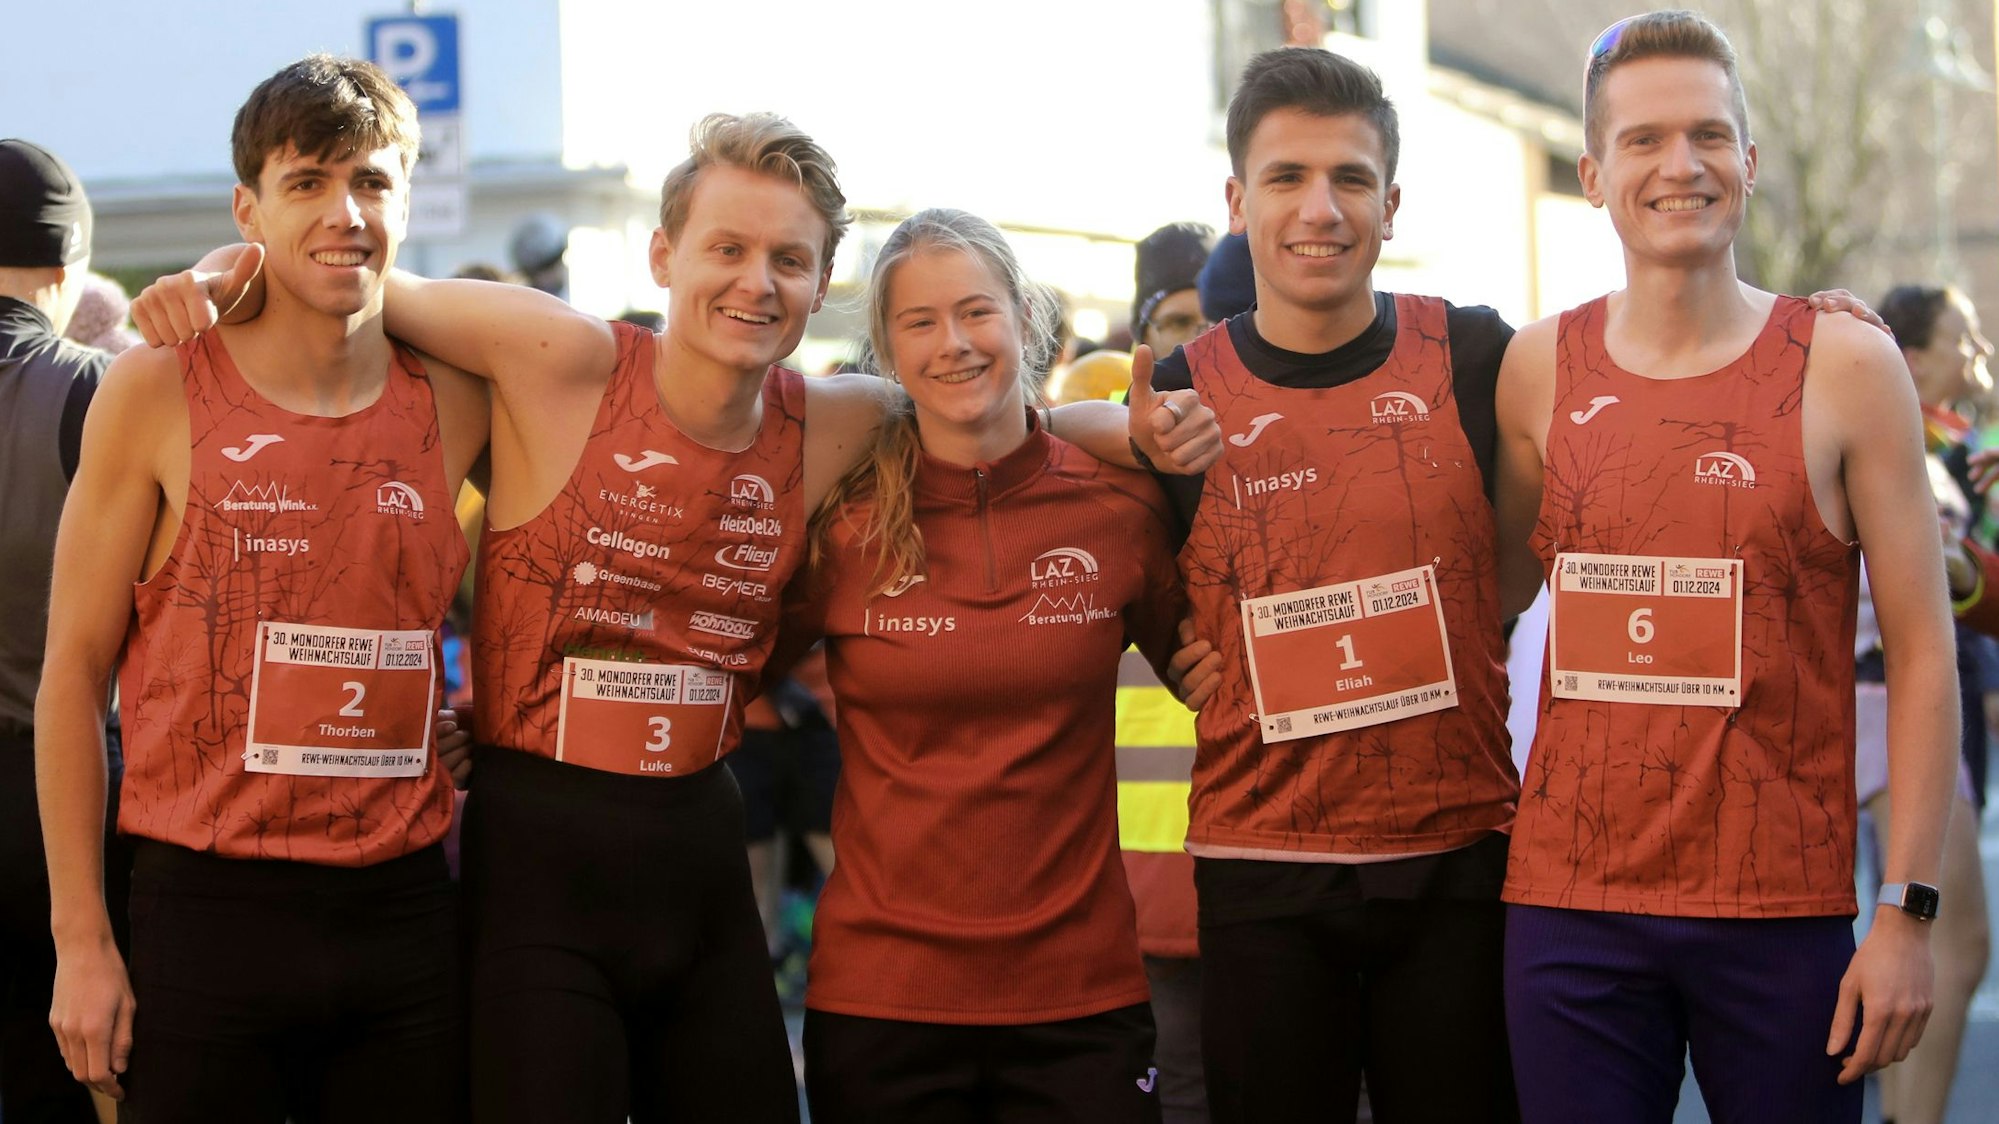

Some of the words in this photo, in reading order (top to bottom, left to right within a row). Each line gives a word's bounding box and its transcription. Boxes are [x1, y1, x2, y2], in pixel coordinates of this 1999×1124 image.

[1370, 400, 1409, 417] LAZ
[1372, 414, 1430, 424] RHEIN-SIEG
[1696, 459, 1736, 478] LAZ
[1246, 467, 1318, 496] inasys
[1694, 476, 1756, 490] RHEIN-SIEG
[377, 489, 408, 508] LAZ
[731, 482, 758, 500] LAZ
[223, 500, 276, 512] Beratung
[600, 489, 684, 519] ENERGETIX
[720, 514, 782, 537] HeizOel24
[246, 534, 310, 556] inasys
[586, 526, 670, 560] Cellagon
[734, 544, 778, 568] Fliegl
[1030, 558, 1075, 581] LAZ
[1566, 562, 1578, 574] 30.
[1580, 562, 1630, 576] MONDORFER
[1632, 565, 1656, 578] REWE
[1696, 569, 1724, 578] REWE
[599, 570, 662, 592] Greenbase
[1032, 572, 1098, 590] RHEIN-SIEG
[1392, 579, 1419, 592] REWE
[1580, 577, 1656, 592] WEIHNACHTSLAUF
[1673, 580, 1720, 594] 01.12.2024
[1258, 606, 1272, 619] 30.
[1273, 596, 1326, 616] MONDORFER
[1328, 591, 1353, 607] REWE
[1372, 592, 1418, 612] 01.12.2024
[878, 614, 956, 636] inasys
[1028, 614, 1082, 625] Beratung
[1274, 604, 1356, 630] WEIHNACHTSLAUF
[1628, 608, 1654, 644] 6
[273, 632, 288, 646] 30.
[291, 634, 346, 650] MONDORFER
[350, 638, 373, 652] REWE
[406, 641, 424, 650] REWE
[289, 648, 372, 666] WEIHNACHTSLAUF
[386, 653, 422, 666] 01.12.2024
[1335, 634, 1363, 670] 1
[1628, 652, 1653, 664] Leo
[580, 668, 594, 682] 30.
[599, 670, 652, 684] MONDORFER
[654, 674, 676, 687] REWE
[1336, 675, 1372, 692] Eliah
[596, 684, 676, 700] WEIHNACHTSLAUF
[1598, 680, 1679, 694] REWE-WEIHNACHTSLAUF
[1682, 682, 1700, 694] ÜBER
[1702, 684, 1710, 694] 10
[1713, 684, 1724, 695] KM
[339, 681, 366, 717] 2
[1314, 699, 1398, 724] REWE-WEIHNACHTSLAUF
[1400, 695, 1419, 708] ÜBER
[1420, 692, 1428, 703] 10
[1430, 688, 1442, 700] KM
[318, 724, 376, 738] Thorben
[645, 716, 672, 752] 3
[302, 754, 380, 765] REWE-WEIHNACHTSLAUF
[380, 755, 396, 766] ÜBER
[397, 756, 404, 766] 10
[404, 756, 413, 766] KM
[640, 760, 672, 772] Luke
